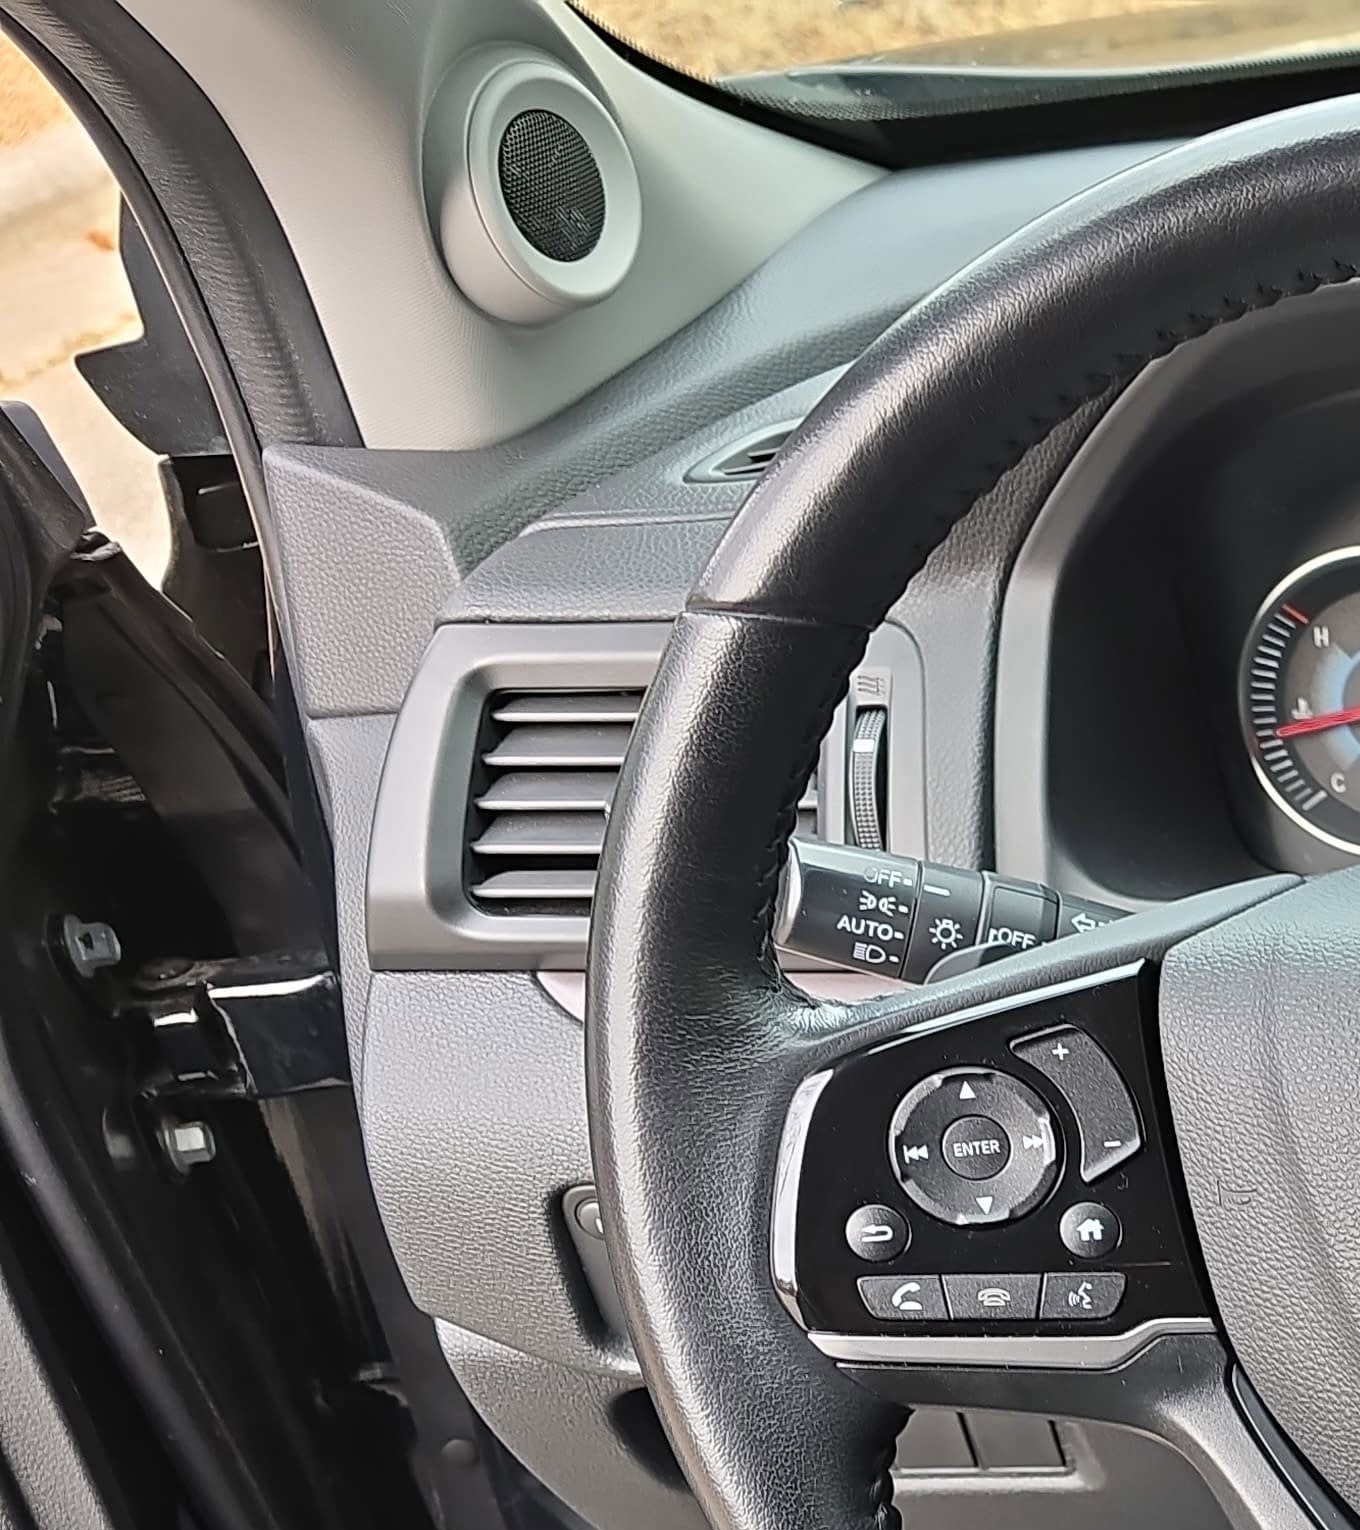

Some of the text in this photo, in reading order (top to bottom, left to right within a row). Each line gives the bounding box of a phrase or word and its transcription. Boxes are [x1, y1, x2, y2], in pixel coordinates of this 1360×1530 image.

[1313, 626, 1330, 647] H
[1331, 772, 1346, 793] C
[864, 867, 901, 888] OFF
[837, 915, 893, 941] AUTO
[953, 1140, 1000, 1158] ENTER
